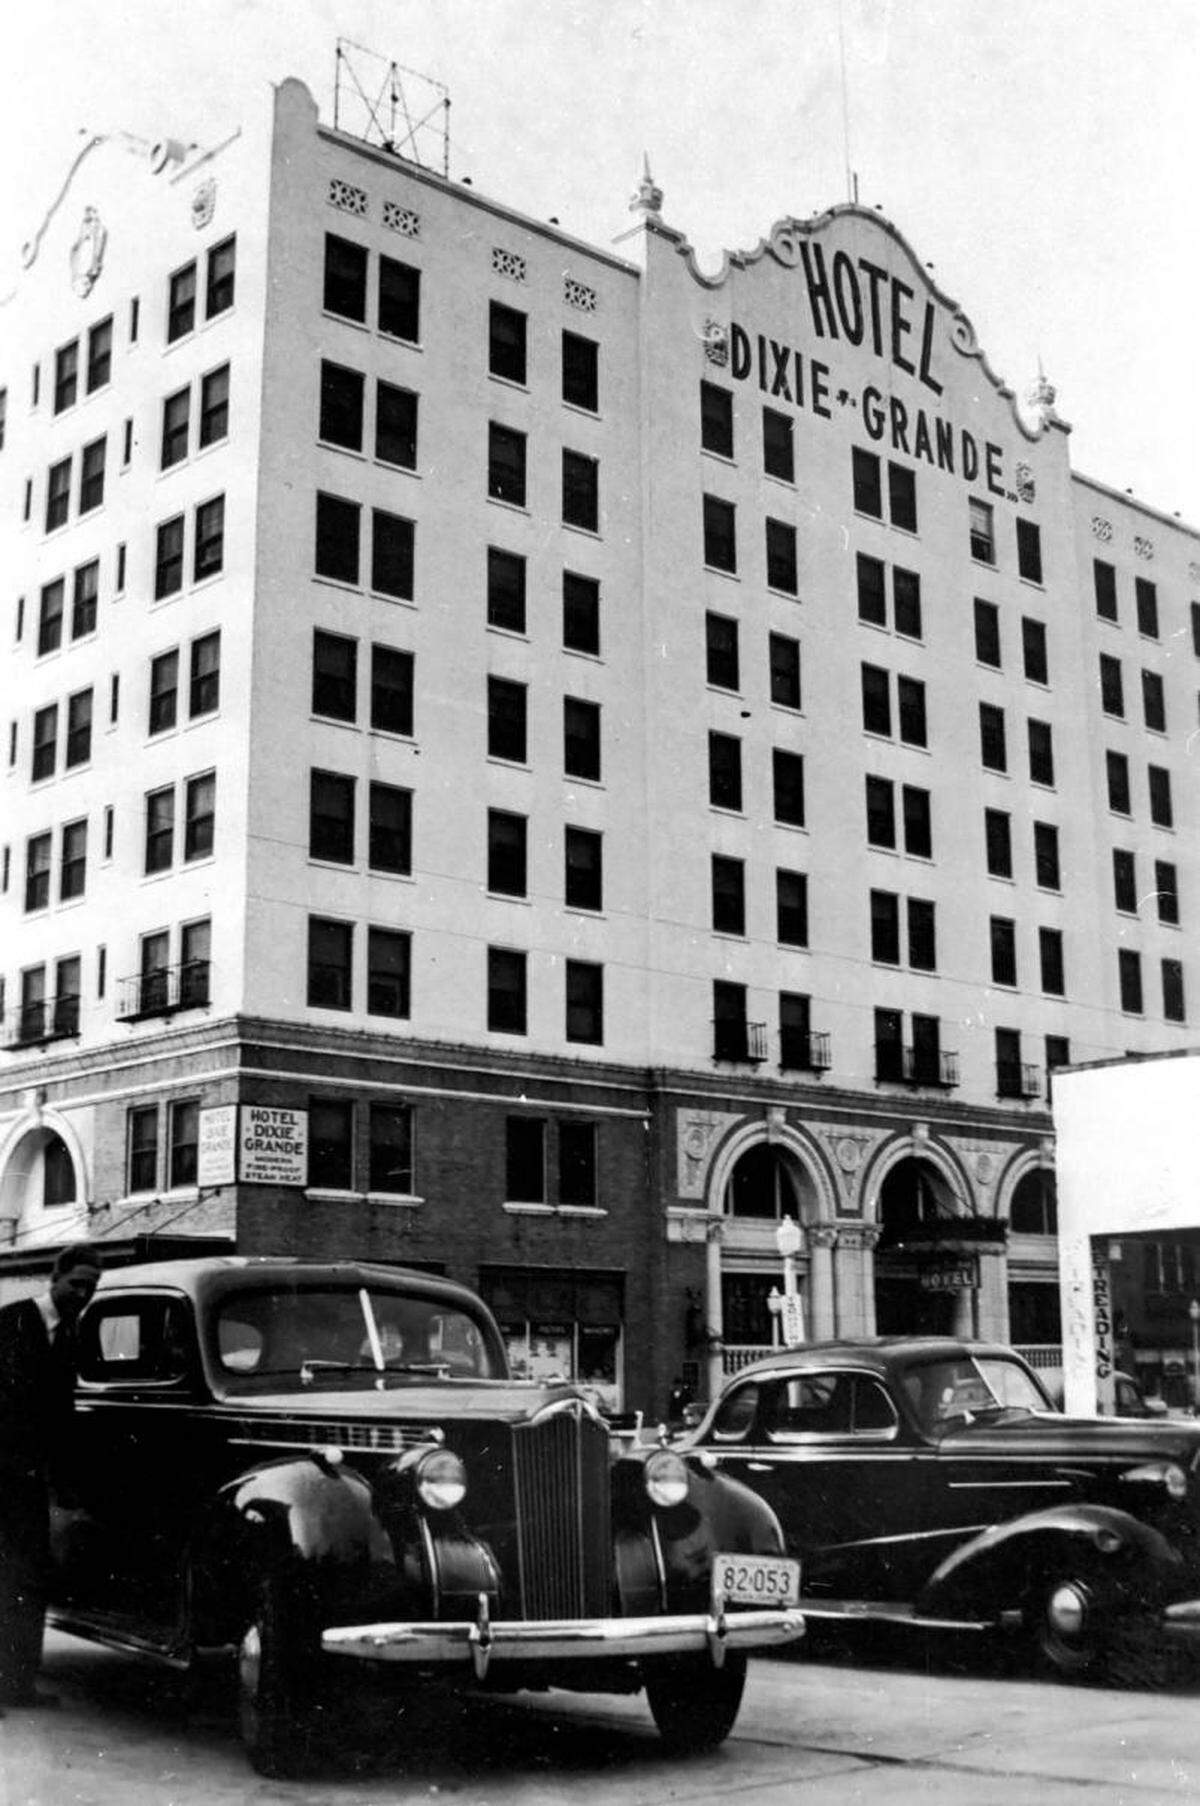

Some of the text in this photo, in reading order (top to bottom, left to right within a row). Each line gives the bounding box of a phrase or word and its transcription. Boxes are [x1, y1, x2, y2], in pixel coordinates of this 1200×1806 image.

[799, 240, 944, 397] HOTEL
[731, 322, 1006, 498] DIXIE GRANDE
[244, 1137, 304, 1155] GRANDE
[250, 1109, 299, 1126] HOTEL
[253, 1124, 295, 1140] DIXIE
[1092, 1238, 1112, 1380] ETREADING
